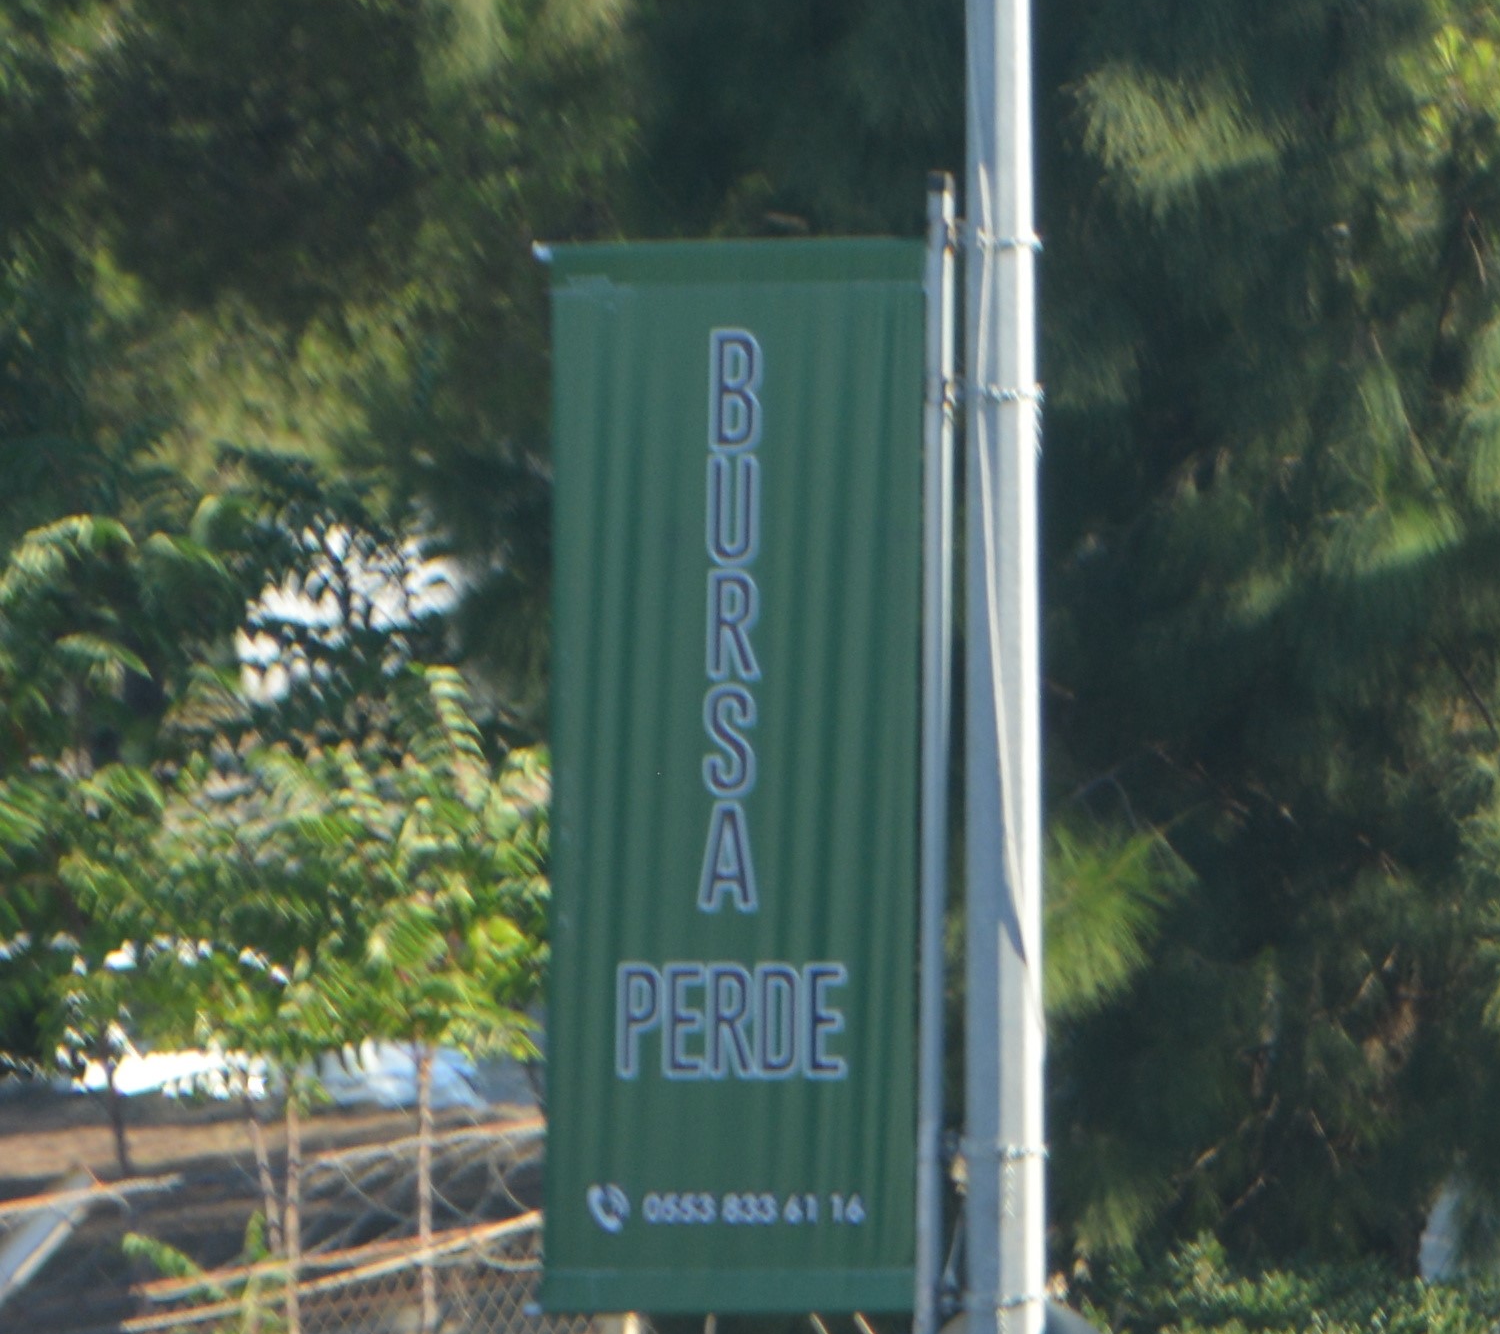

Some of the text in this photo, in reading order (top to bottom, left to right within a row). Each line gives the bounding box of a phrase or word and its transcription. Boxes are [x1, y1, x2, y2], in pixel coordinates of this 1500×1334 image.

[697, 327, 763, 913] BURSA
[615, 961, 849, 1080] PERDE
[643, 1192, 866, 1224] 0553 833 61 16
